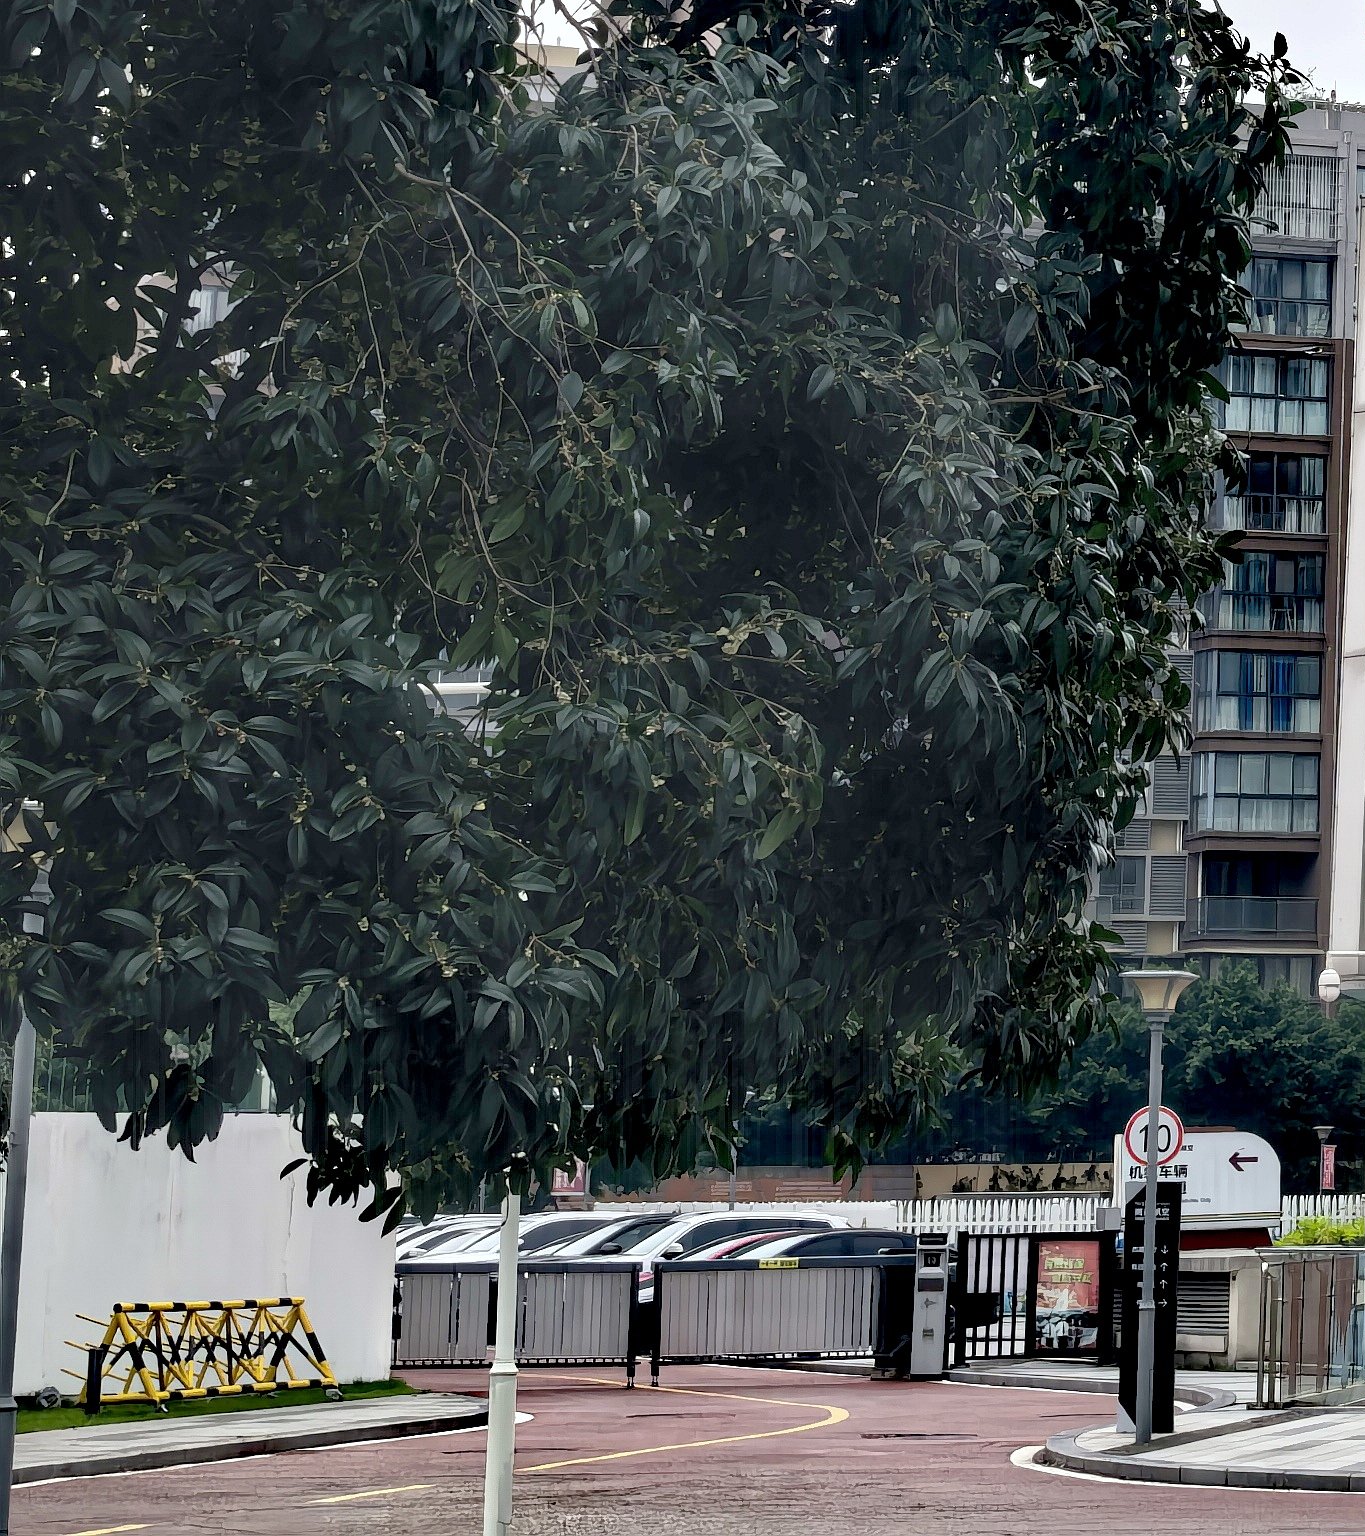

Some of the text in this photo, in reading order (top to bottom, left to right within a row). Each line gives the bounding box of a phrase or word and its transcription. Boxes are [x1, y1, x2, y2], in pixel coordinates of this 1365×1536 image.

[1139, 1124, 1171, 1153] 10
[1129, 1164, 1188, 1179] 机车辆
